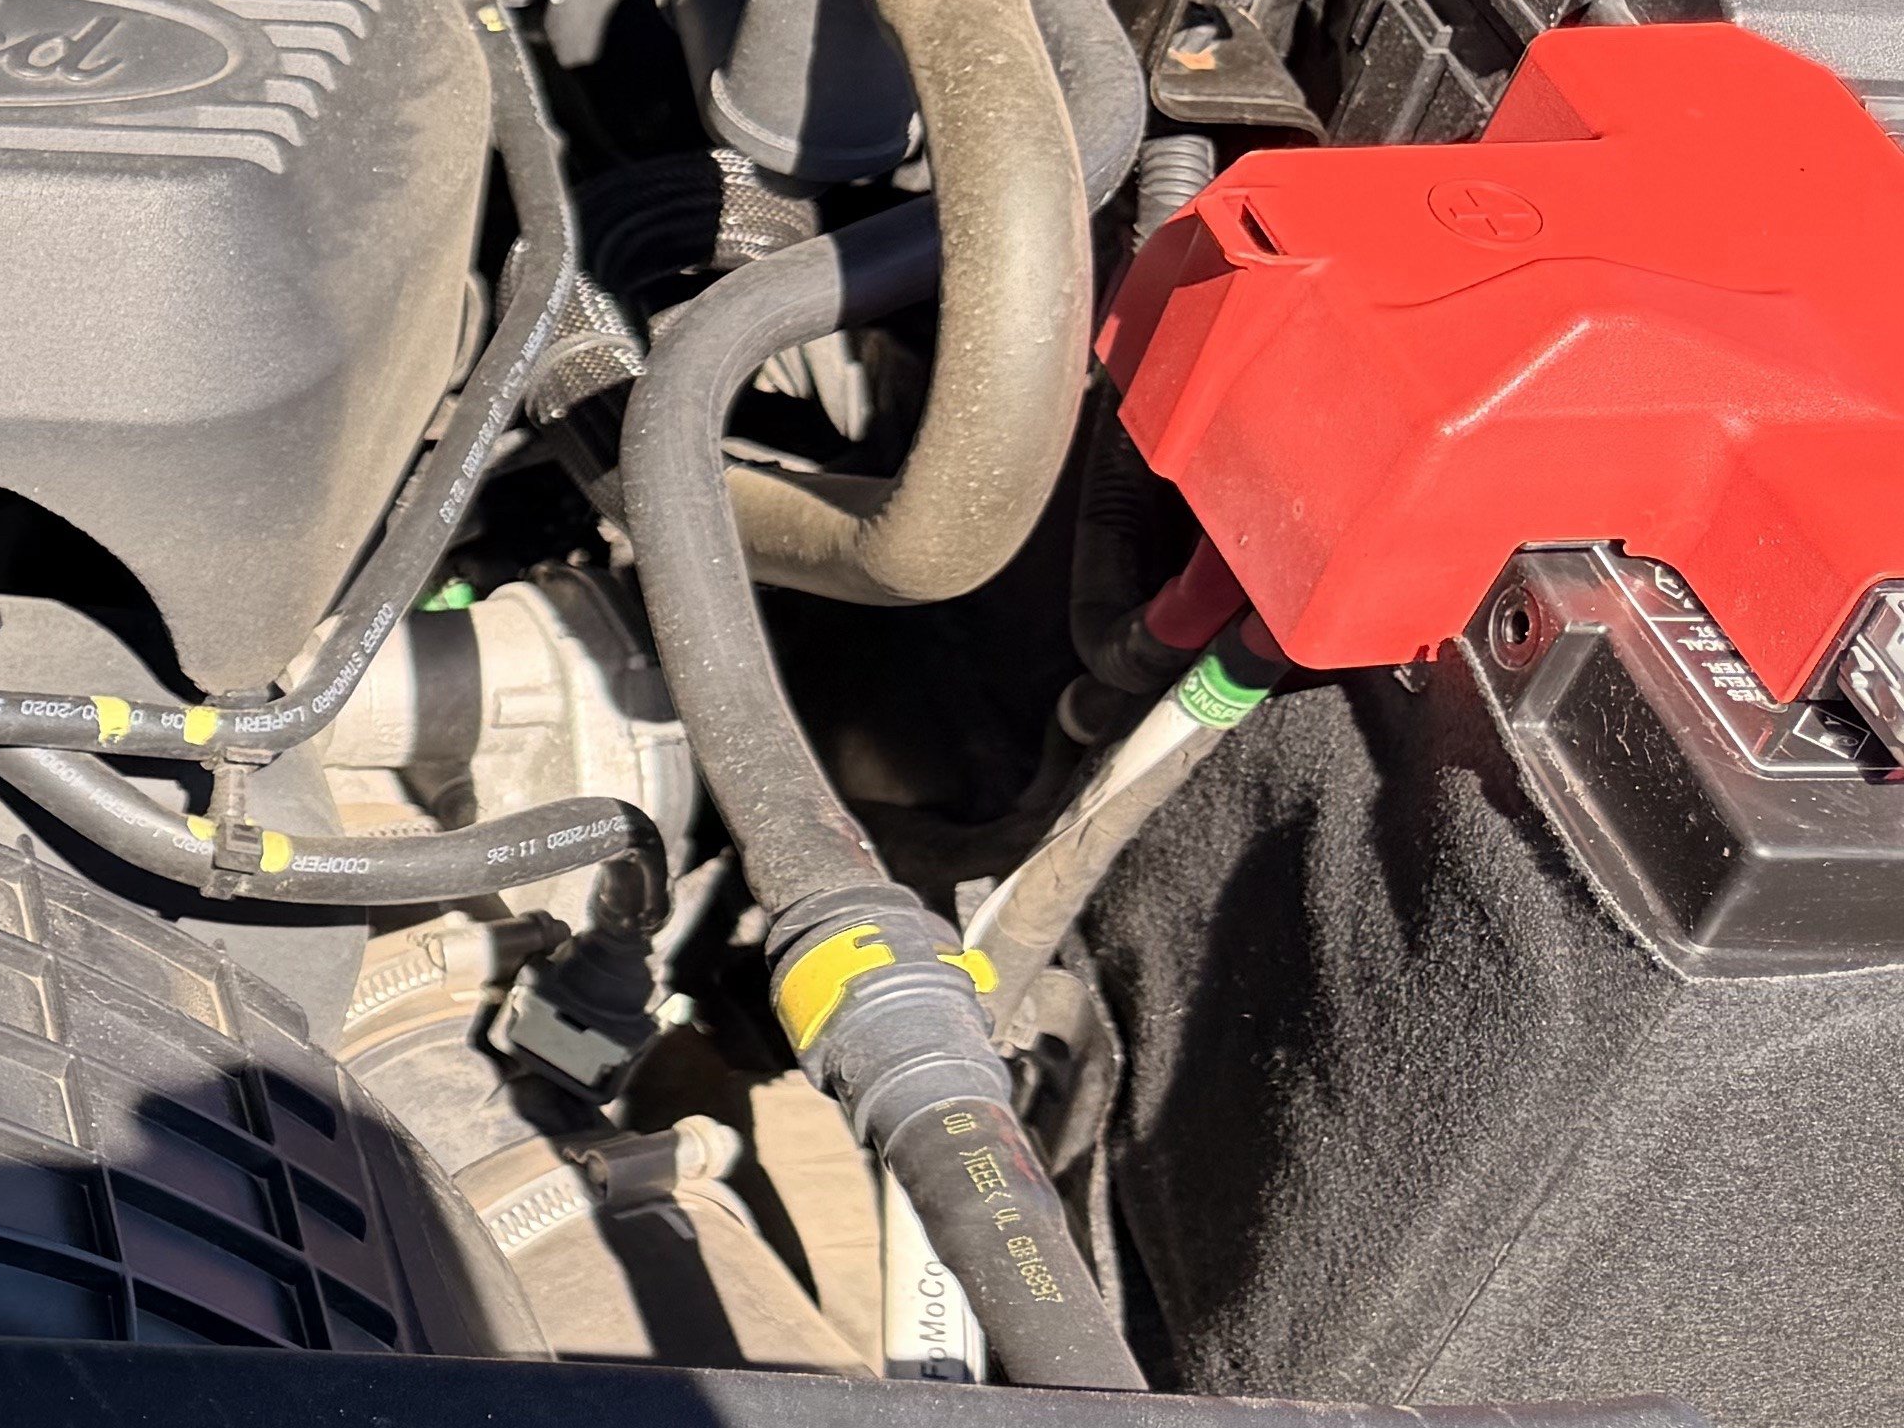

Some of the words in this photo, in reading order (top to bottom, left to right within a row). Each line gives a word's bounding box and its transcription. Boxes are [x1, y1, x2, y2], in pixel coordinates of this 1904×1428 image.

[1701, 662, 1745, 674] TER.
[289, 853, 371, 875] COOPER
[486, 839, 537, 866] 11:26
[918, 1259, 947, 1379] FoMoCo
